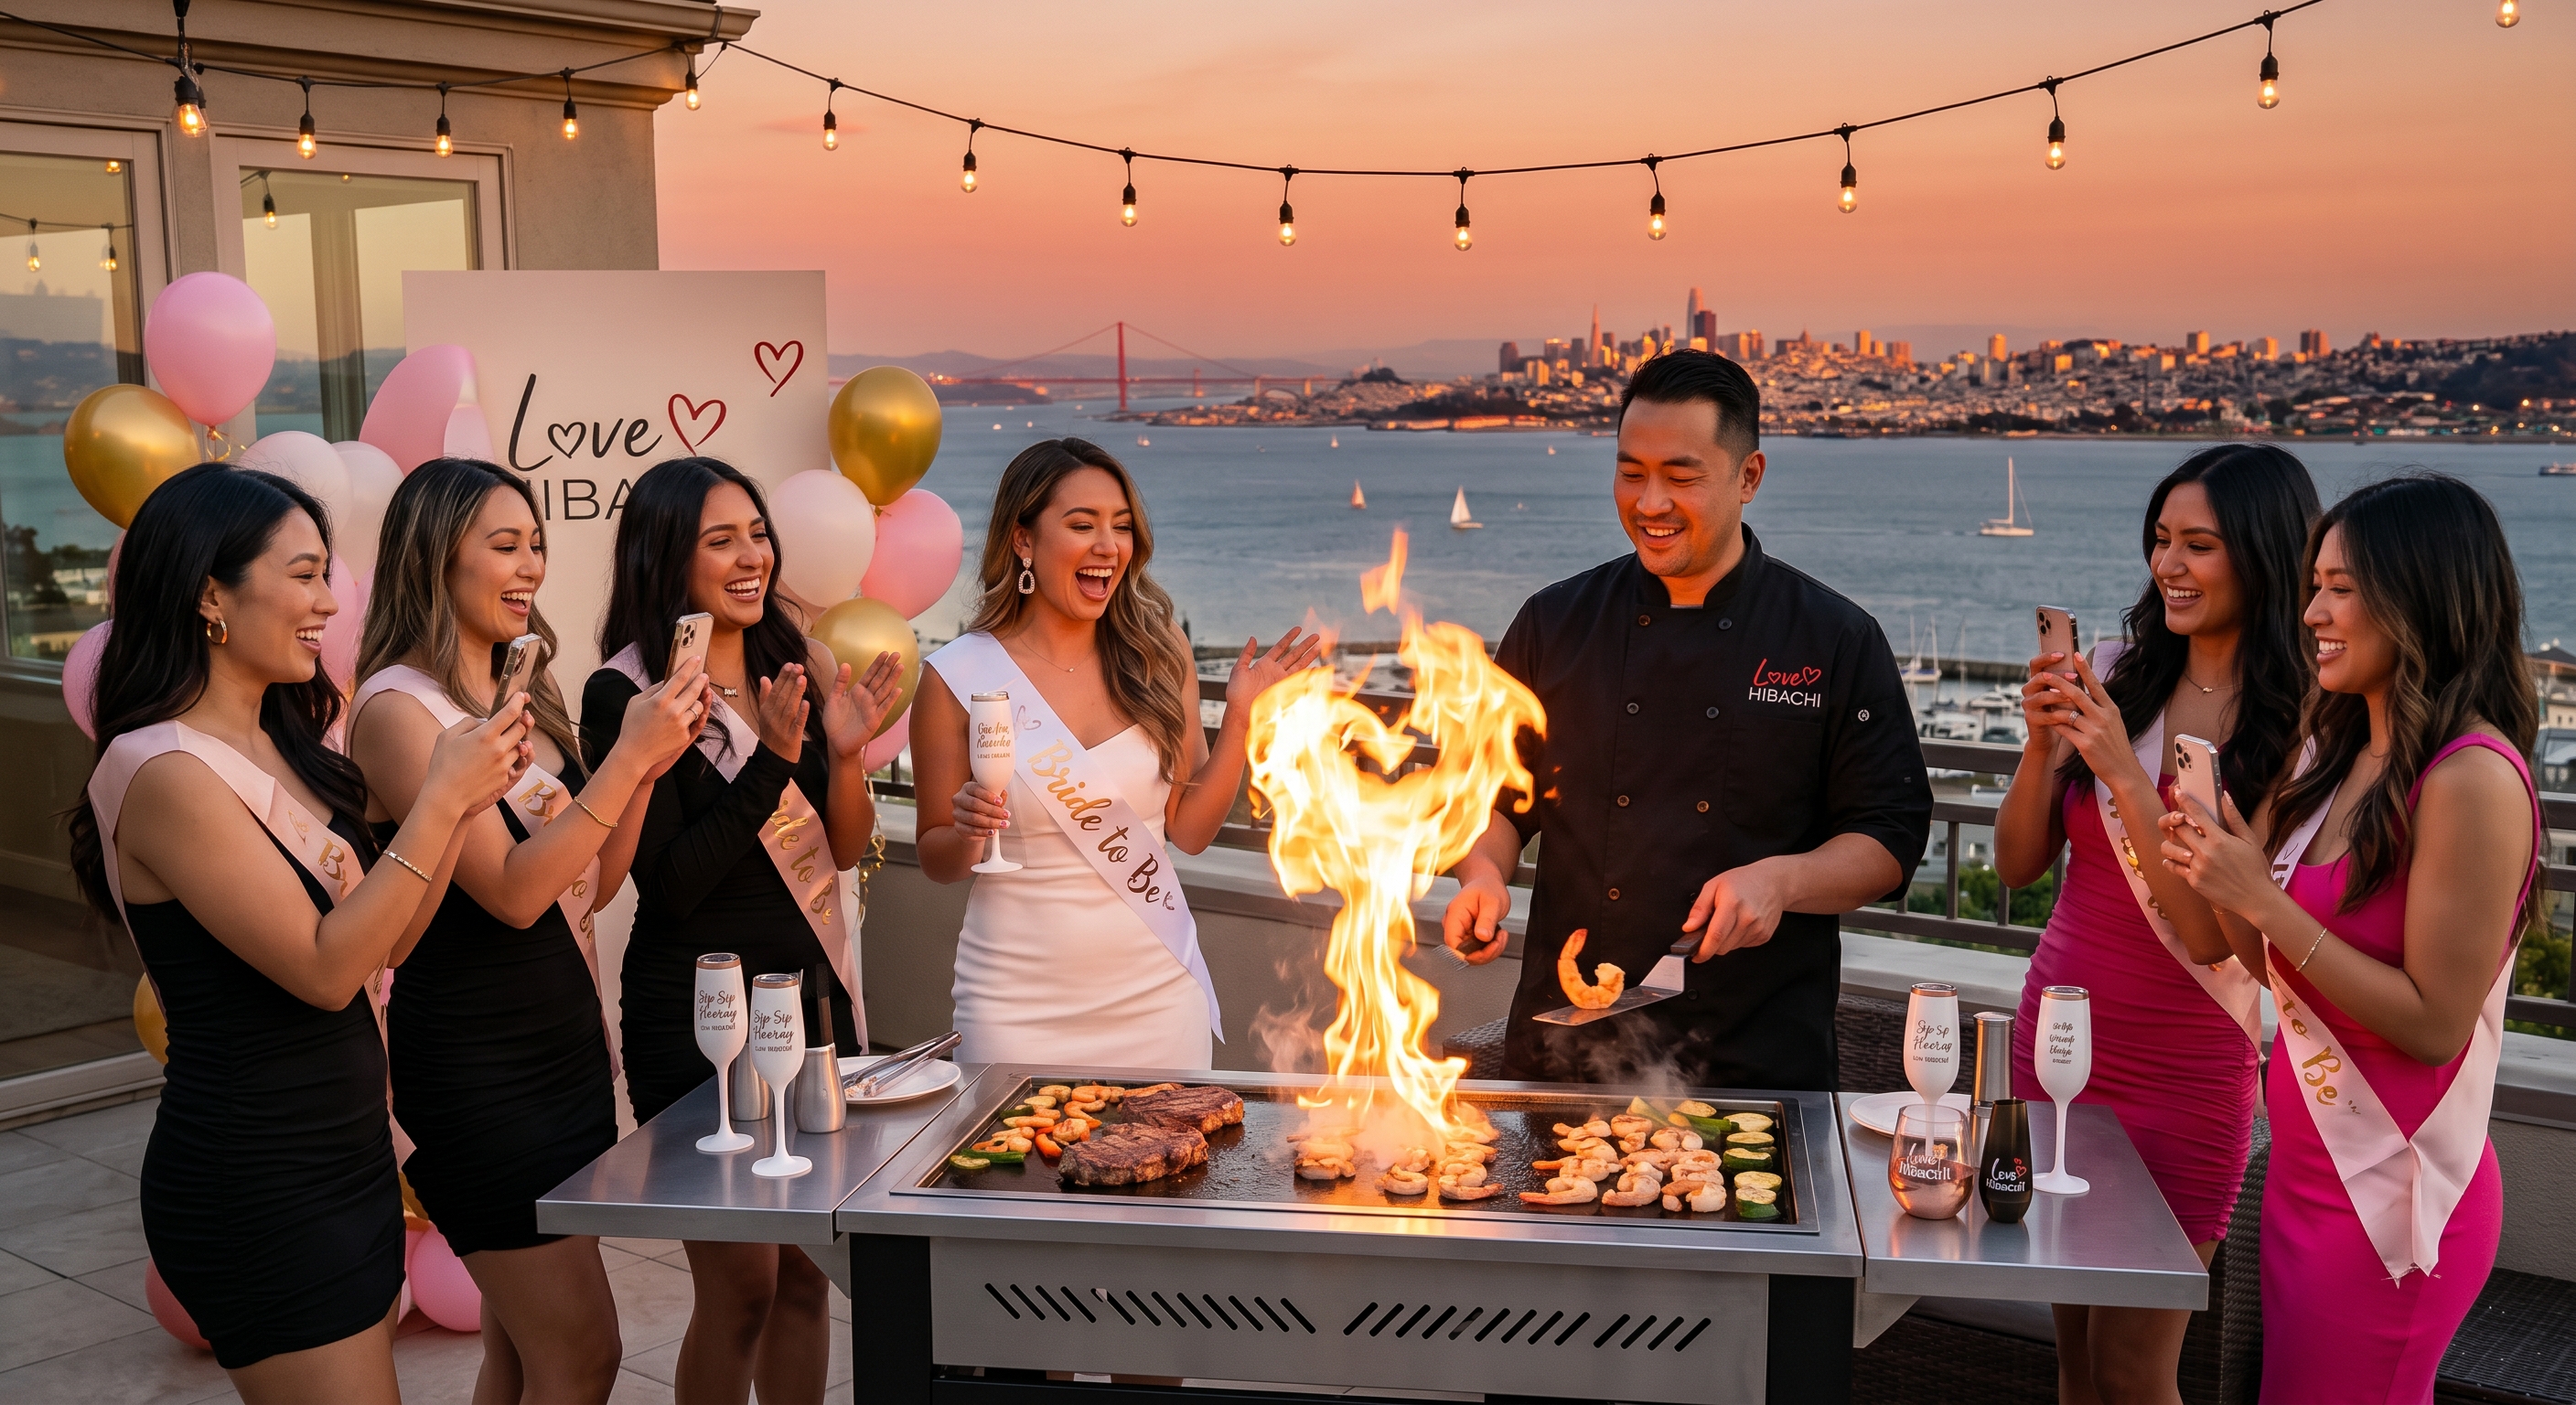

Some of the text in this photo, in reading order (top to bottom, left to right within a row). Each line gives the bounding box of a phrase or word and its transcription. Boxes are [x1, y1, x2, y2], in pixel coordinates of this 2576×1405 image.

[508, 372, 663, 472] Love
[1753, 658, 1804, 687] Love
[1748, 687, 1821, 708] HIBACHI
[1027, 738, 1160, 904] Bride to Be
[769, 799, 835, 926] ide to Be
[716, 990, 736, 1009] Sip
[773, 1009, 793, 1029] Sip
[2302, 1046, 2342, 1106] Be
